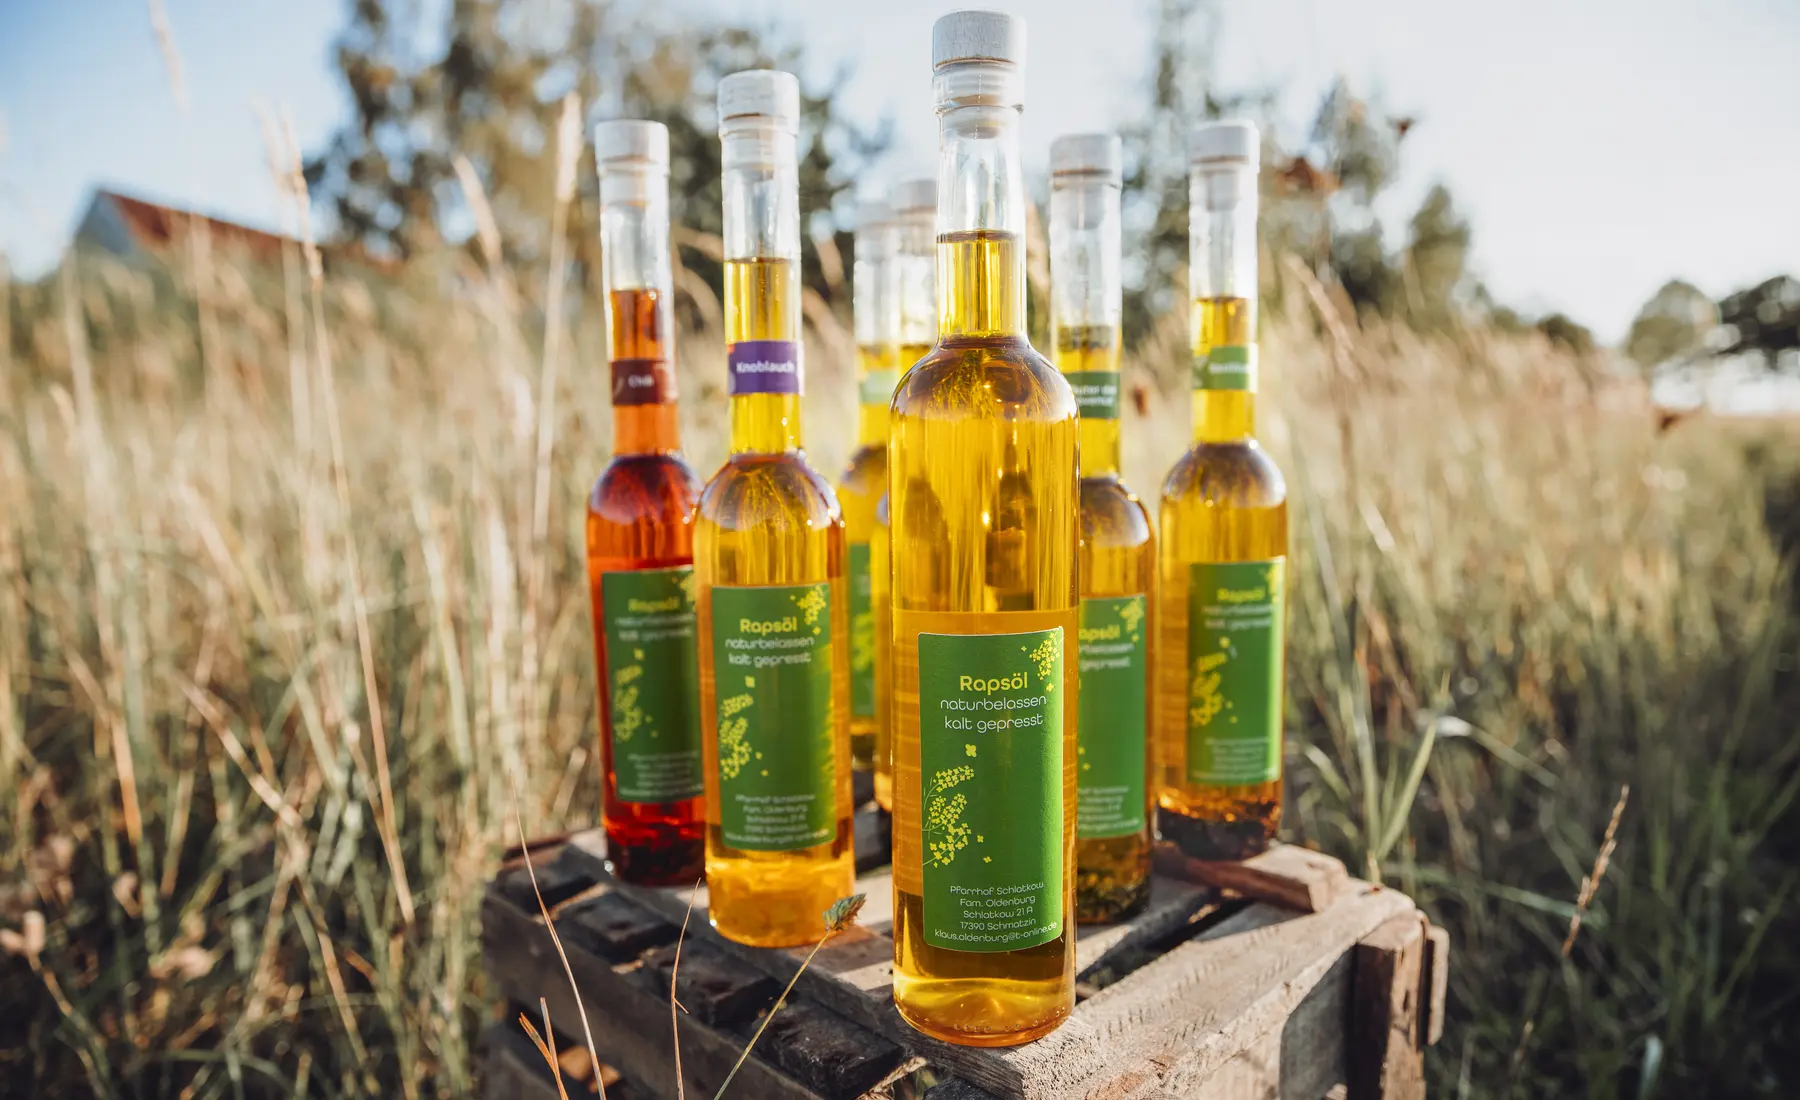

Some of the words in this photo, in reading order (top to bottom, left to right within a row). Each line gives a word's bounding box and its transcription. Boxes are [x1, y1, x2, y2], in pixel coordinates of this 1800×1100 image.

[736, 360, 795, 374] Knoblauch
[739, 617, 798, 636] Rapsöl
[1079, 625, 1121, 643] apsöl
[725, 635, 815, 650] naturbelassen
[728, 652, 752, 666] kalt
[753, 651, 812, 668] gepresst
[959, 671, 1028, 696] Rapsöl
[940, 695, 1047, 711] naturbelassen
[944, 716, 973, 730] kalt
[976, 713, 1044, 734] gepresst
[950, 885, 994, 896] Pfarrhof
[996, 881, 1045, 895] Schlatkow
[960, 898, 983, 907] Fam.
[985, 894, 1036, 908] Oldenburg
[963, 908, 1014, 919] Schlatkow
[1016, 907, 1025, 917] 21
[1026, 906, 1034, 915] A
[934, 921, 1057, 943] klaus.oldenburg@t-online.de
[960, 921, 985, 931] 17390
[987, 917, 1037, 930] Schmatzin
